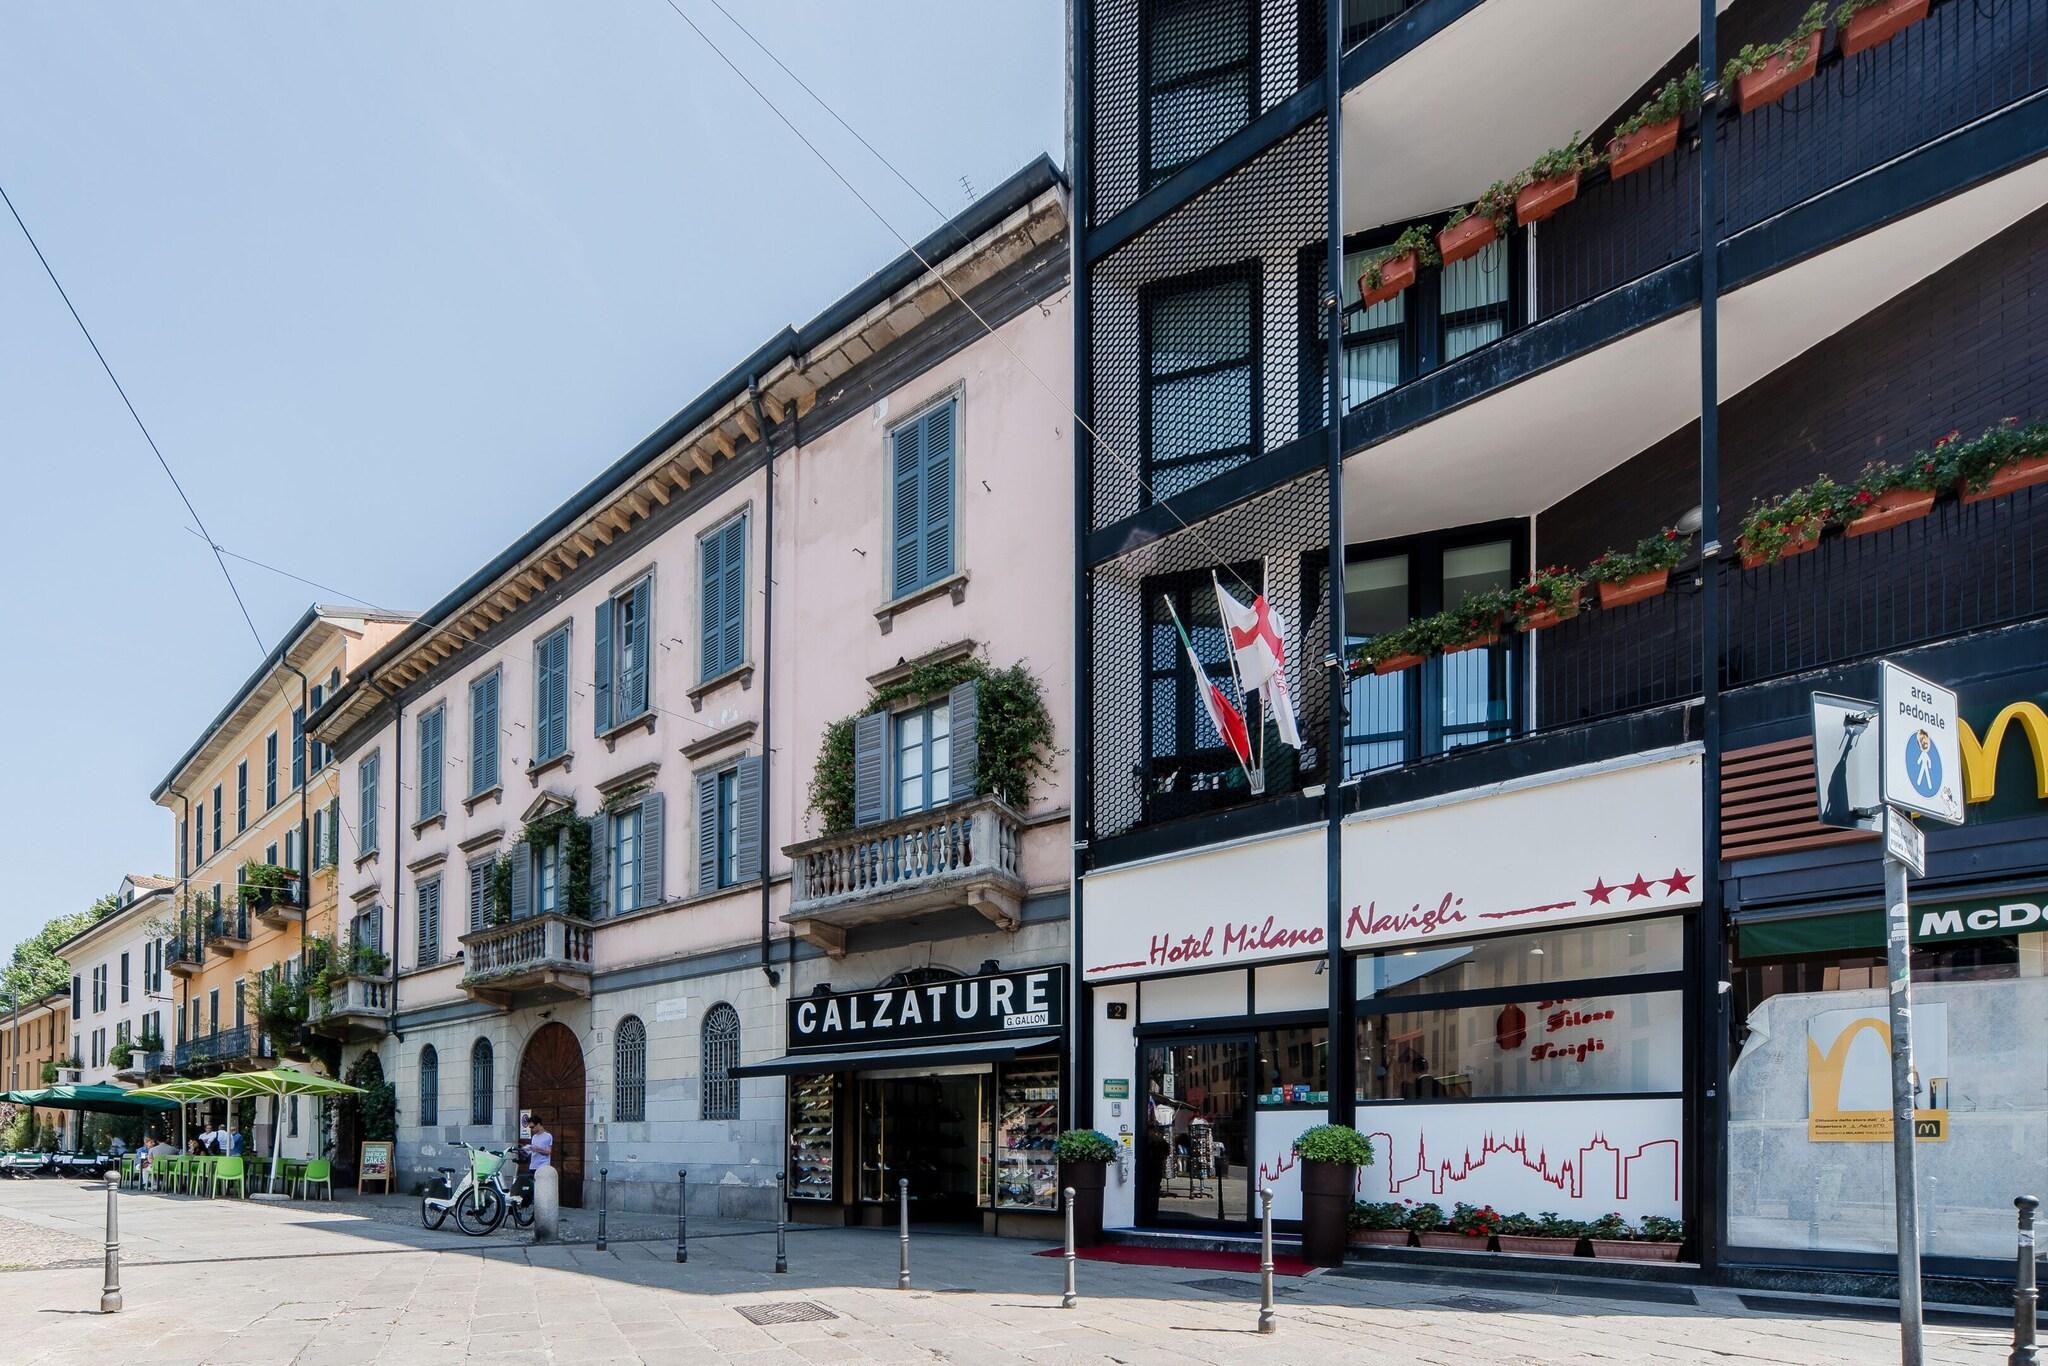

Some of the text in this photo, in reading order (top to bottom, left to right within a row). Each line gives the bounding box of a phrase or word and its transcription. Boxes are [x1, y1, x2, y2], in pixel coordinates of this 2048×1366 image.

[1911, 684, 1933, 705] area
[1899, 701, 1945, 729] pedonale
[1150, 891, 1467, 966] Hotel Milano Navigli
[1919, 903, 2048, 936] McD
[797, 973, 1049, 1034] CALZATURE
[1114, 1005, 1122, 1017] 2
[364, 1156, 387, 1165] CAKES
